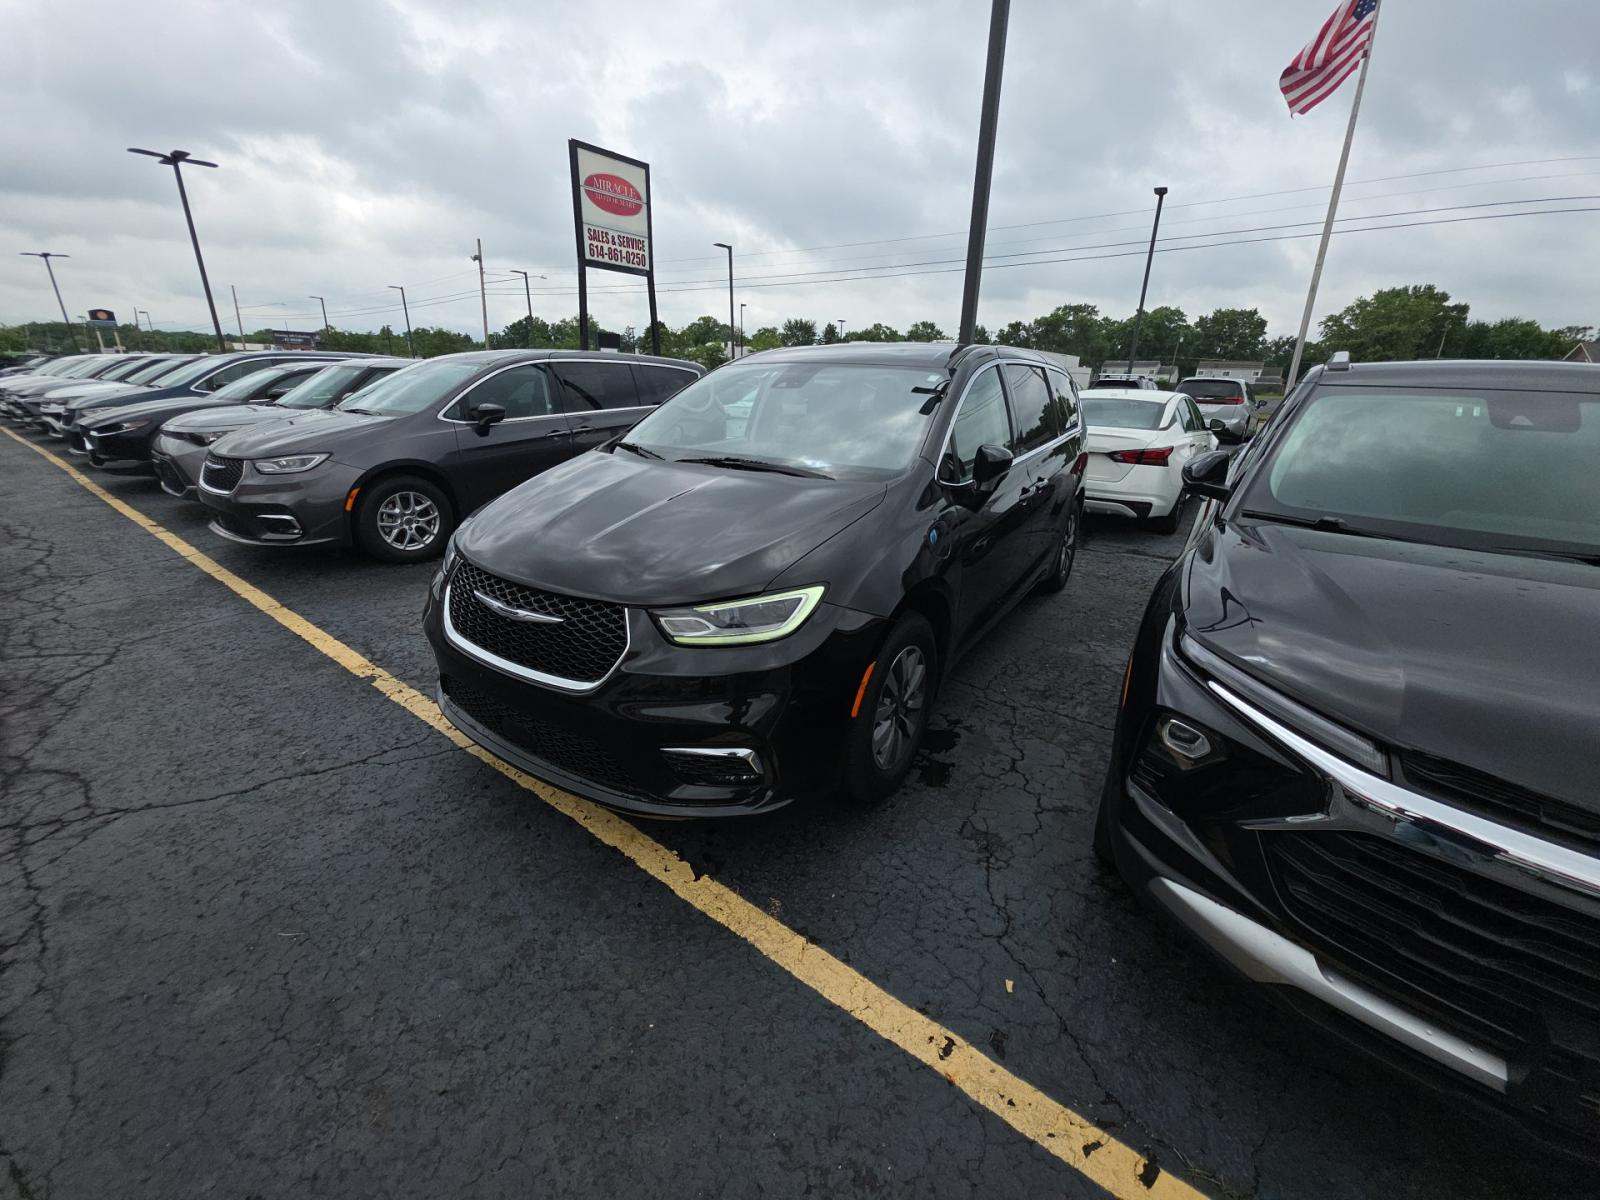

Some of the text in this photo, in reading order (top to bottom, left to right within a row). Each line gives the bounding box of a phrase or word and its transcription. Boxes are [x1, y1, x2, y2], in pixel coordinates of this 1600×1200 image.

[592, 176, 636, 198] MIRACLE
[587, 228, 646, 252] SALES & SERVICE
[588, 243, 647, 267] 614-861-0250
